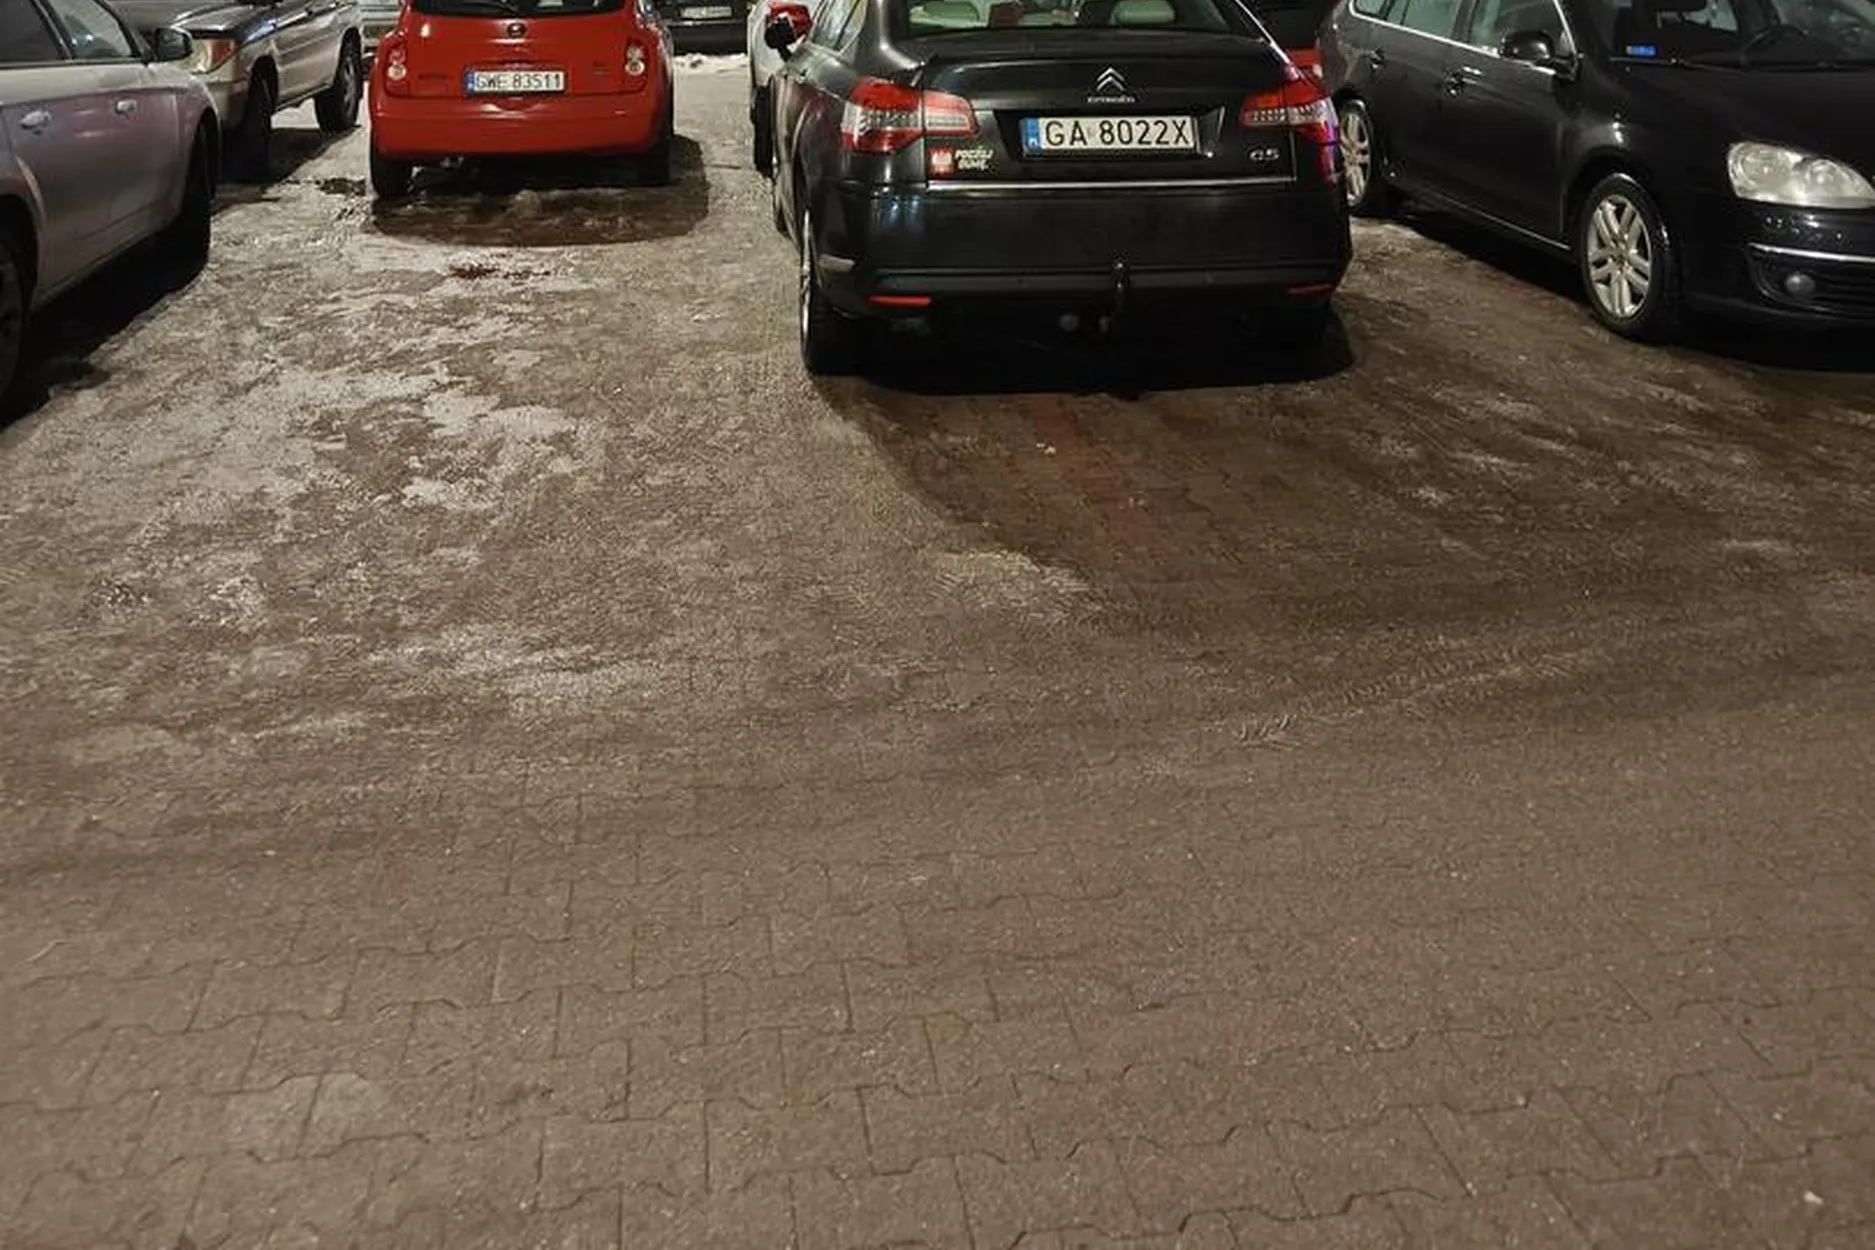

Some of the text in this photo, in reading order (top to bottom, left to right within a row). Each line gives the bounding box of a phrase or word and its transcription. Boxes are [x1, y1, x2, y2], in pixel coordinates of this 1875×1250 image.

[512, 73, 561, 89] 83511
[1045, 119, 1190, 146] GA 8022X
